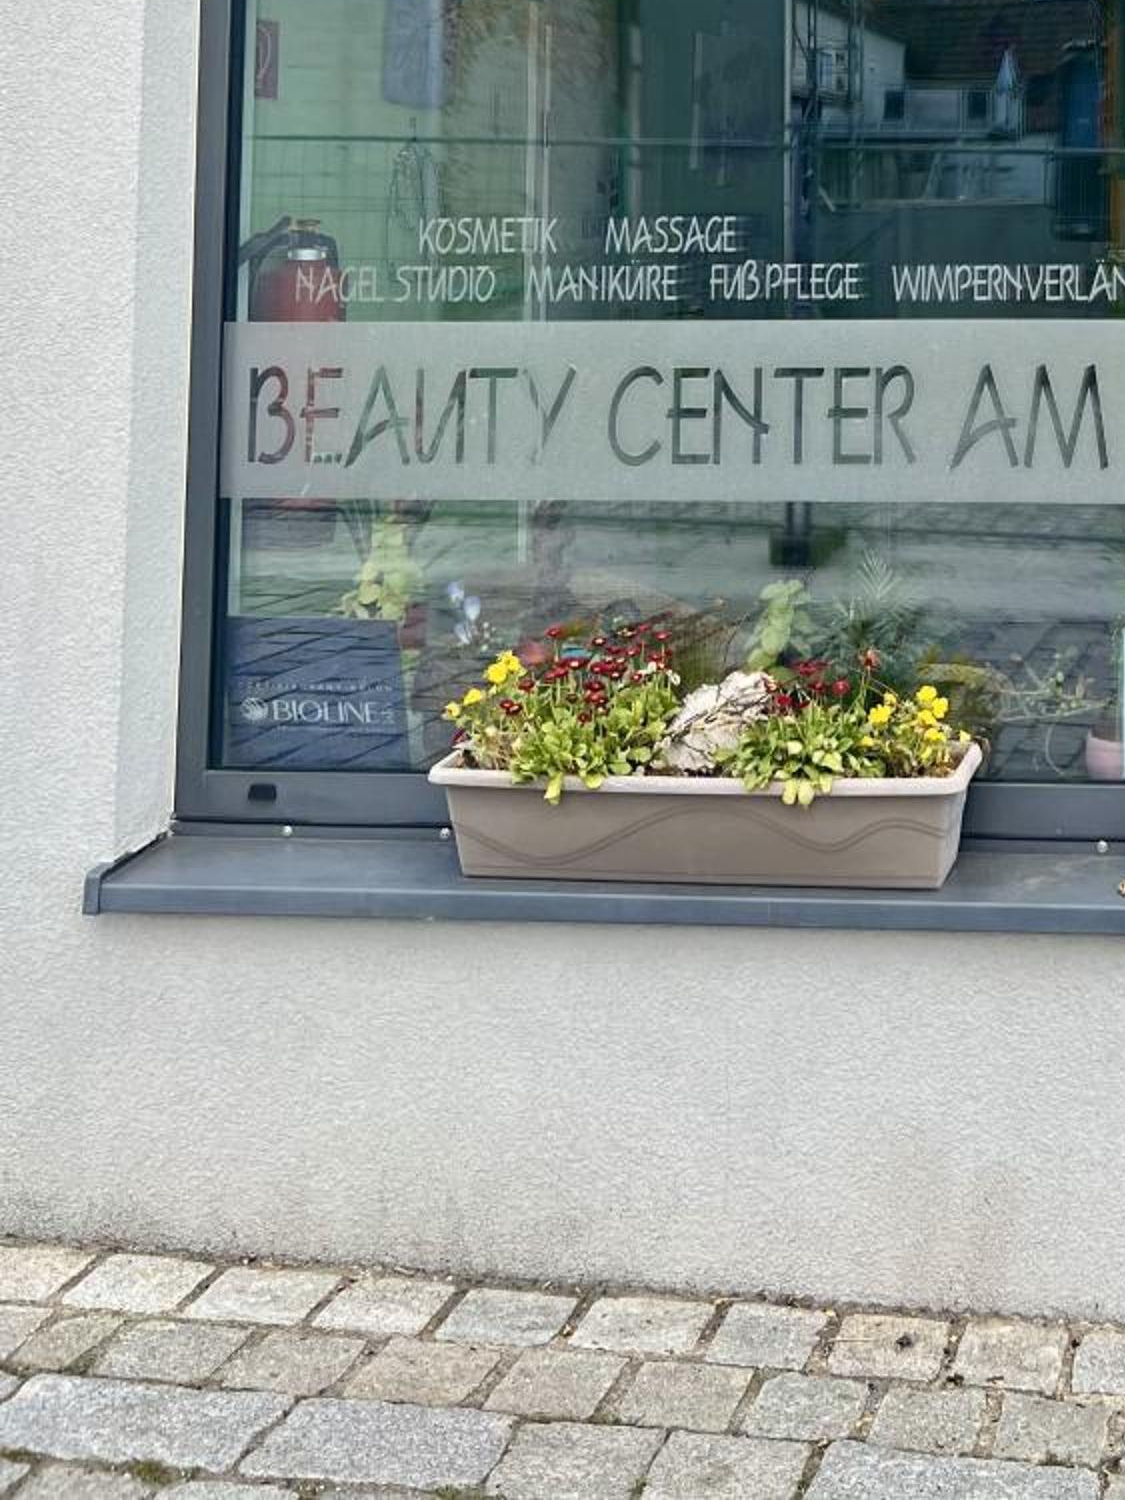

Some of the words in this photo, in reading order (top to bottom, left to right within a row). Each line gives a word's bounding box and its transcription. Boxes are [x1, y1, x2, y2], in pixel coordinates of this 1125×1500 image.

[419, 216, 558, 254] KOSMETIK
[604, 216, 737, 252] MASSAGE
[295, 265, 385, 301] NAGEL
[394, 265, 496, 301] STUDIO
[523, 257, 676, 301] MANIKÜRE
[246, 365, 577, 467] BEAUTY
[607, 364, 917, 466] CENTER
[949, 364, 1109, 469] AM
[272, 700, 380, 724] BIOLINE
